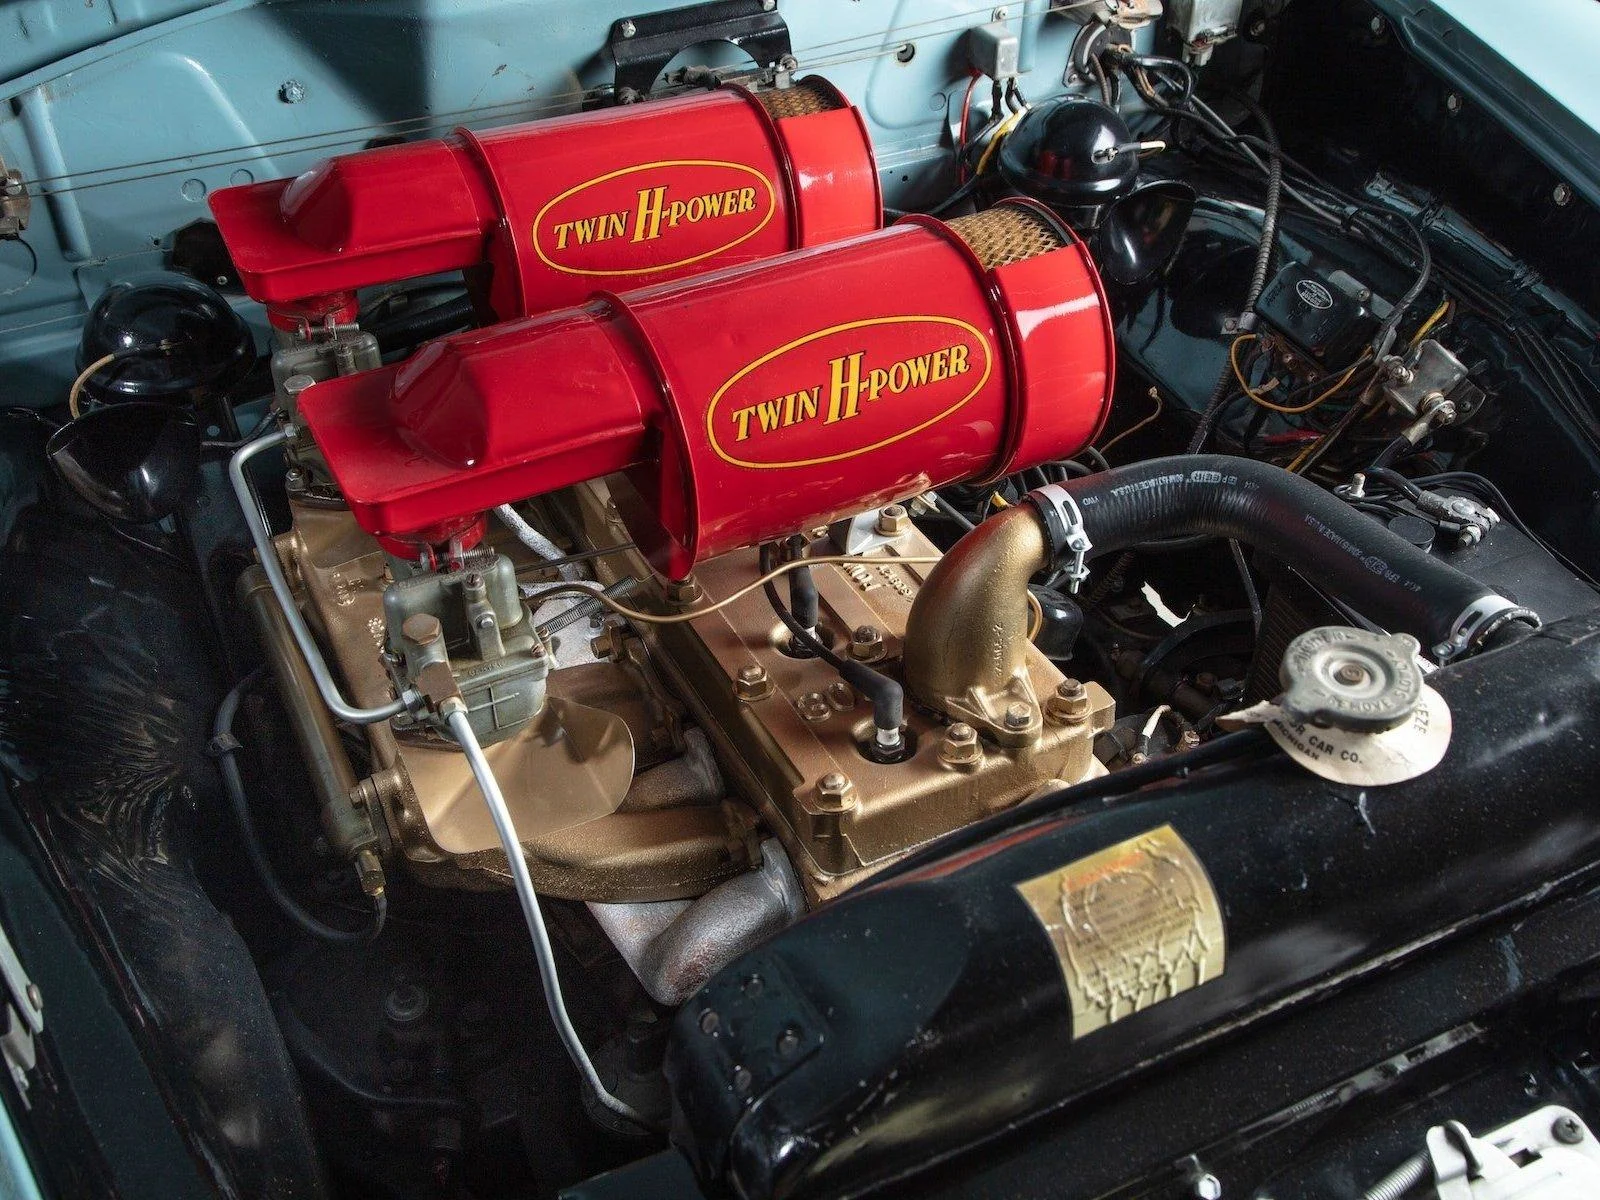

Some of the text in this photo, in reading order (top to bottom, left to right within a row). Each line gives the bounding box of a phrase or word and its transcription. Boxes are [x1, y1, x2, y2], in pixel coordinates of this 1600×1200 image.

[553, 185, 757, 250] TWIN H-POWER
[731, 344, 971, 442] TWIN H-POWER
[1308, 735, 1335, 755] CAR
[1340, 749, 1362, 763] CO.
